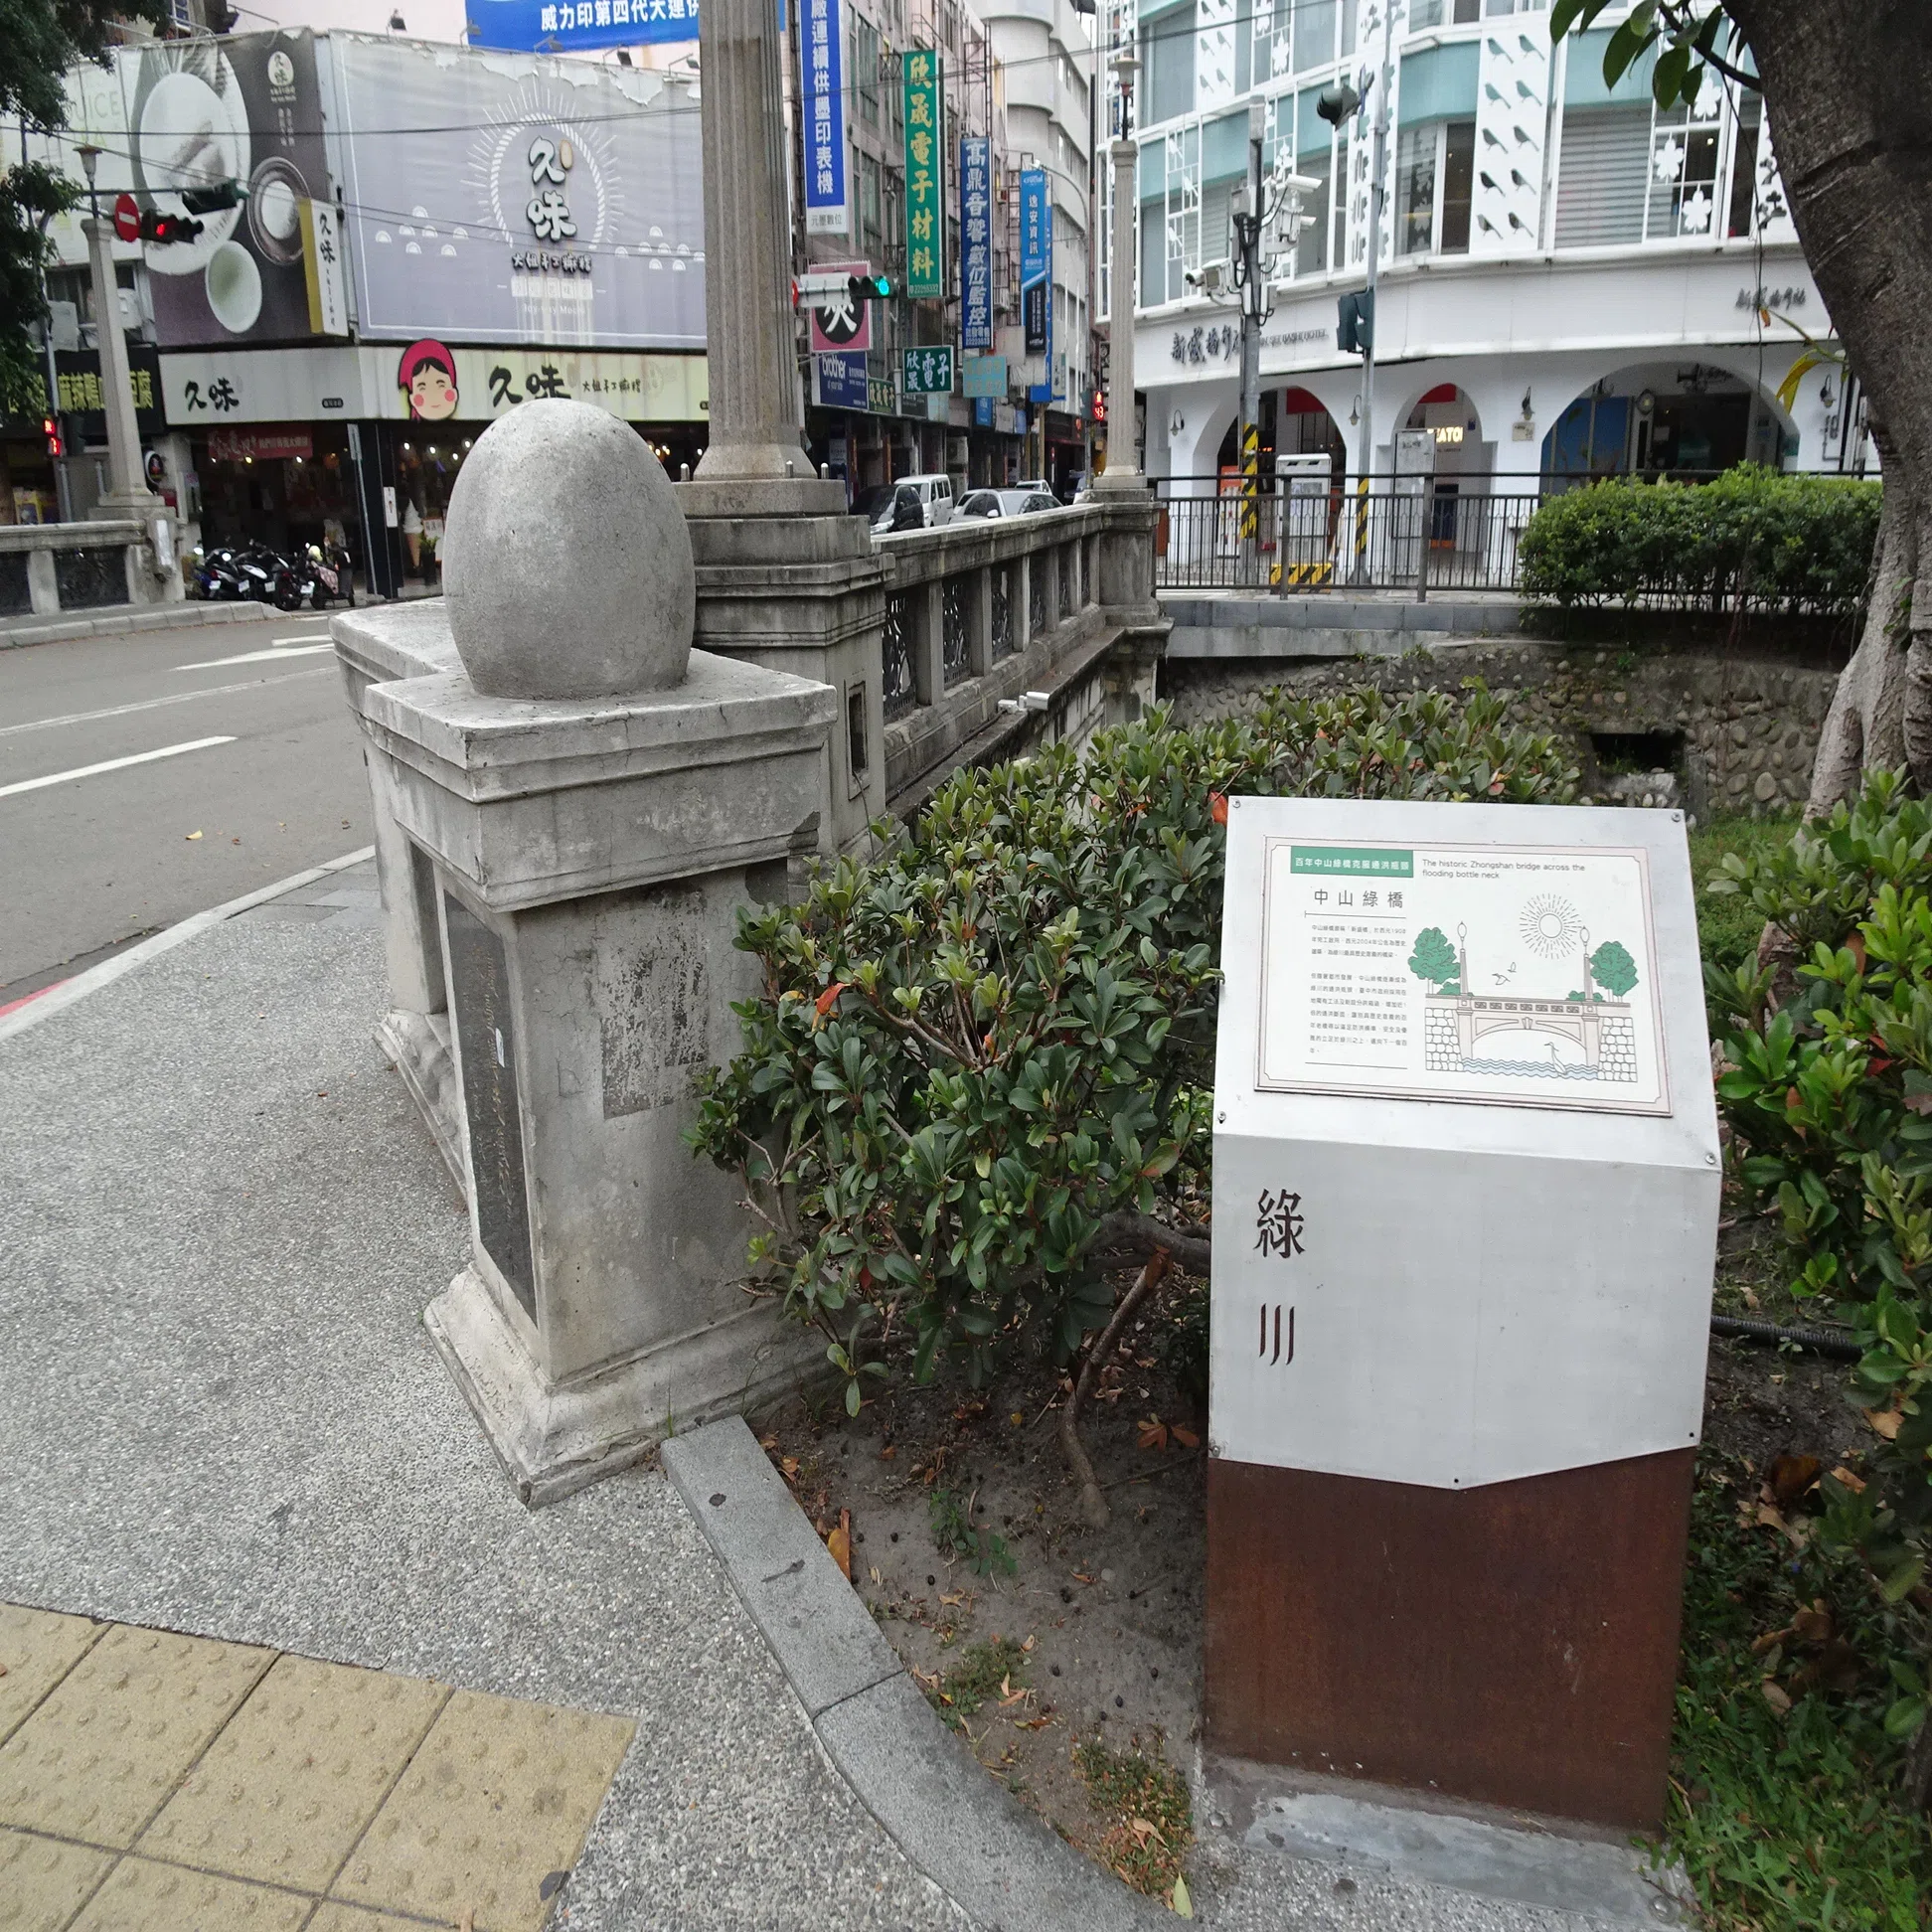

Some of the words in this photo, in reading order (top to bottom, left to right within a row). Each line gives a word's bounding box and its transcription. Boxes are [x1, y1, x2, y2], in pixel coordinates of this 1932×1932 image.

[185, 377, 241, 412] 久味
[1095, 405, 1104, 418] 43
[1439, 860, 1468, 869] historic
[1471, 861, 1514, 871] Zhongshan
[1517, 862, 1541, 872] bridge
[1422, 869, 1454, 879] flooding
[1456, 870, 1480, 879] bottle
[1482, 871, 1500, 880] neck
[1314, 888, 1403, 908] 中山綠橋
[1253, 1188, 1305, 1367] 綠川
